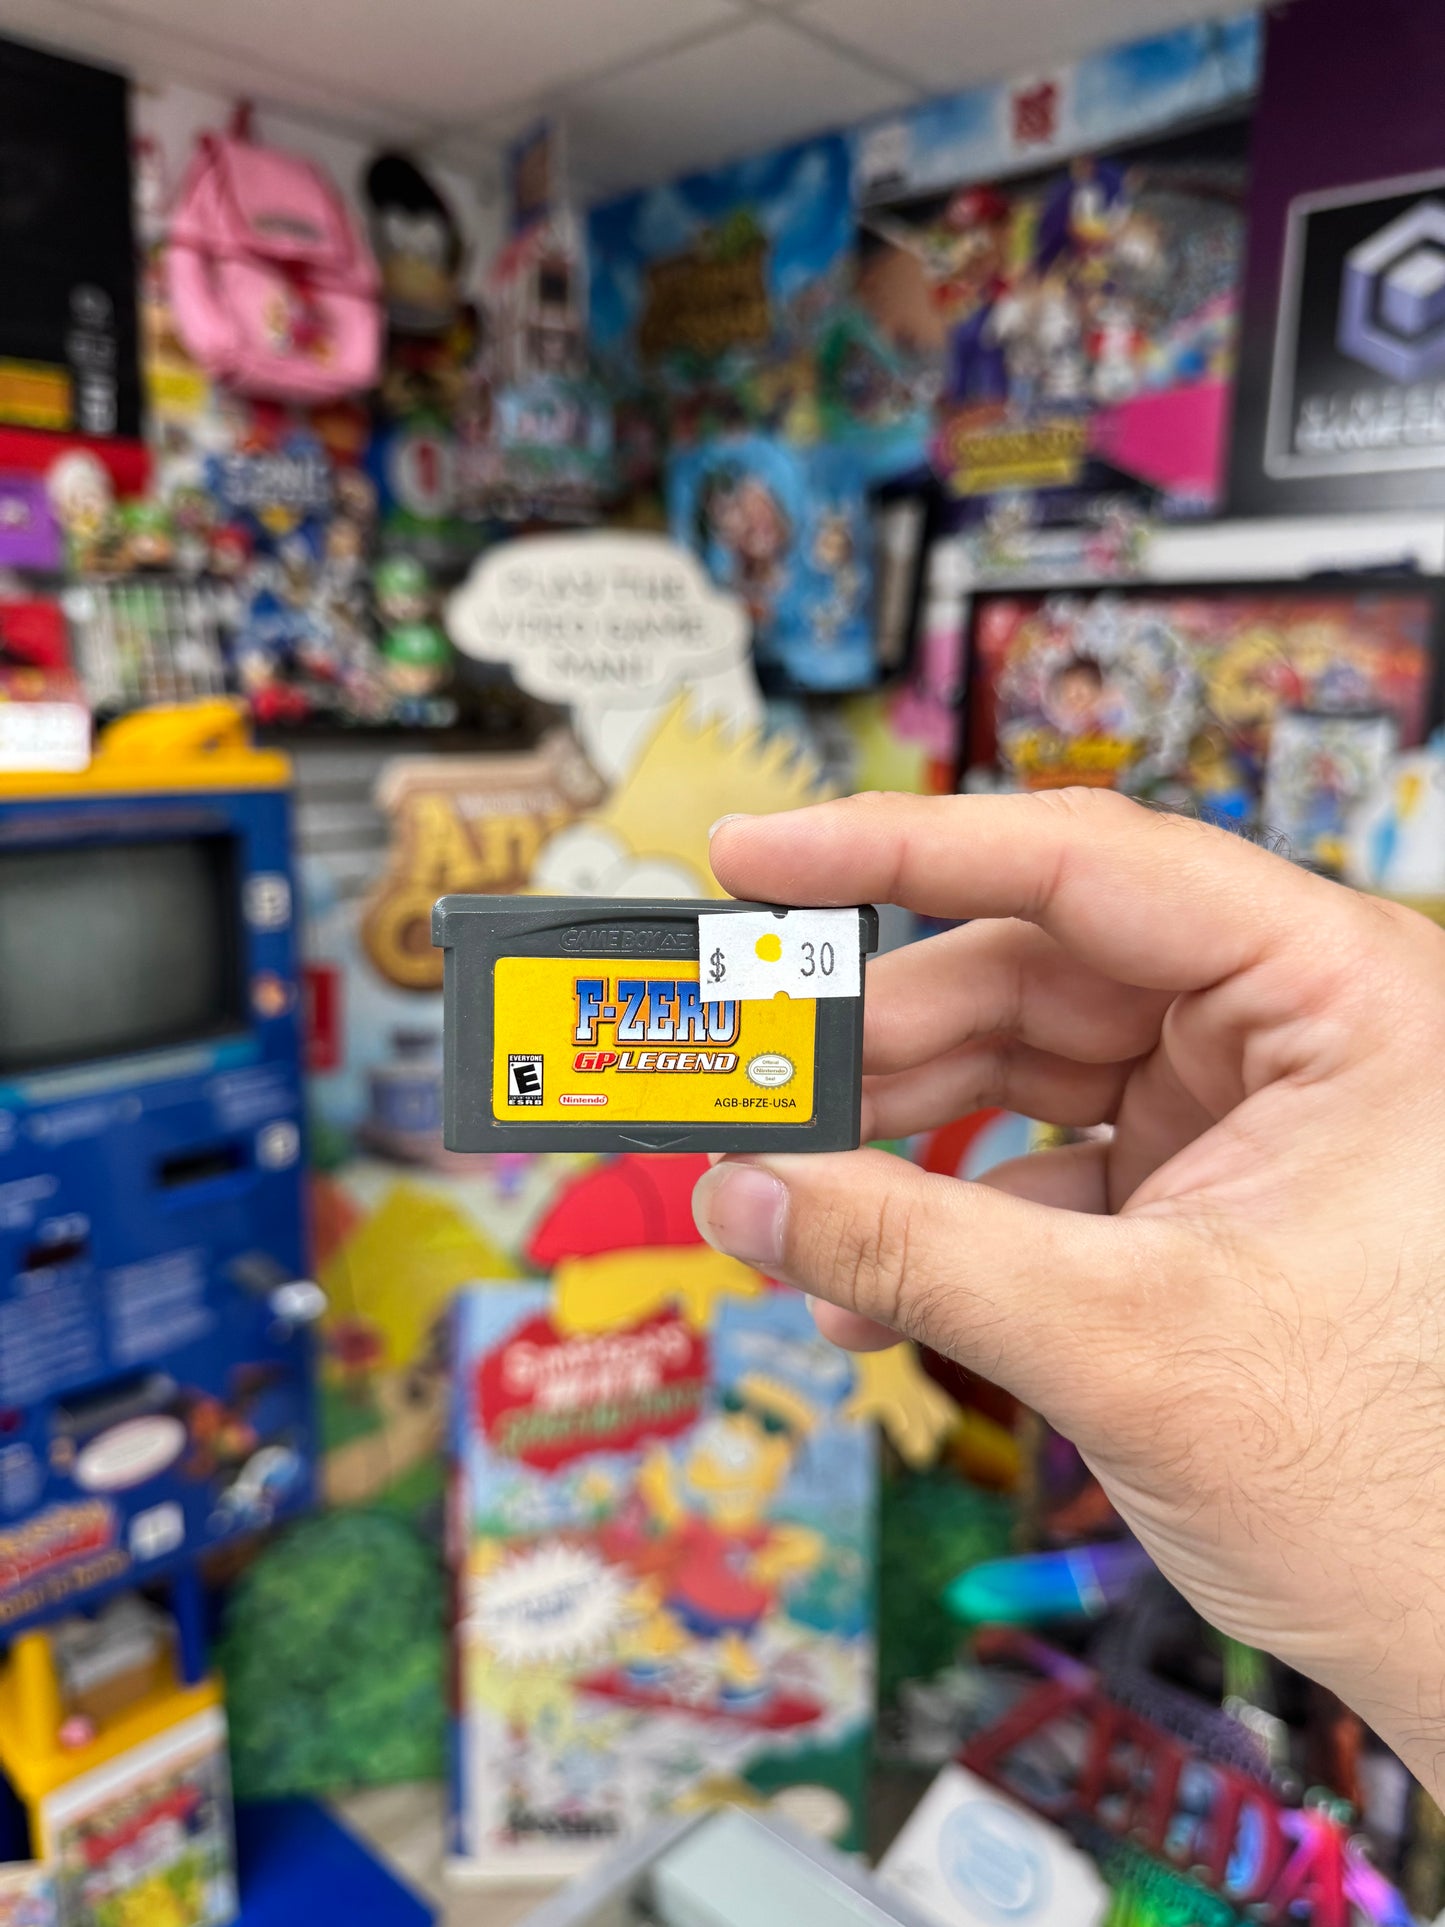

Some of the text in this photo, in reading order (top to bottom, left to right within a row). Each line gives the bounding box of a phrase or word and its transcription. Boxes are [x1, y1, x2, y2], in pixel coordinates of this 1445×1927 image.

[560, 928, 620, 952] GAME
[621, 929, 661, 952] BOY
[709, 941, 835, 983] $ 30
[573, 978, 740, 1045] F-ZERO
[509, 1054, 542, 1062] EVERYONE
[574, 1051, 738, 1072] GP LEGEND
[512, 1063, 542, 1095] E
[562, 1096, 606, 1104] Nintendo
[714, 1097, 797, 1108] AGB-BFZE-USA
